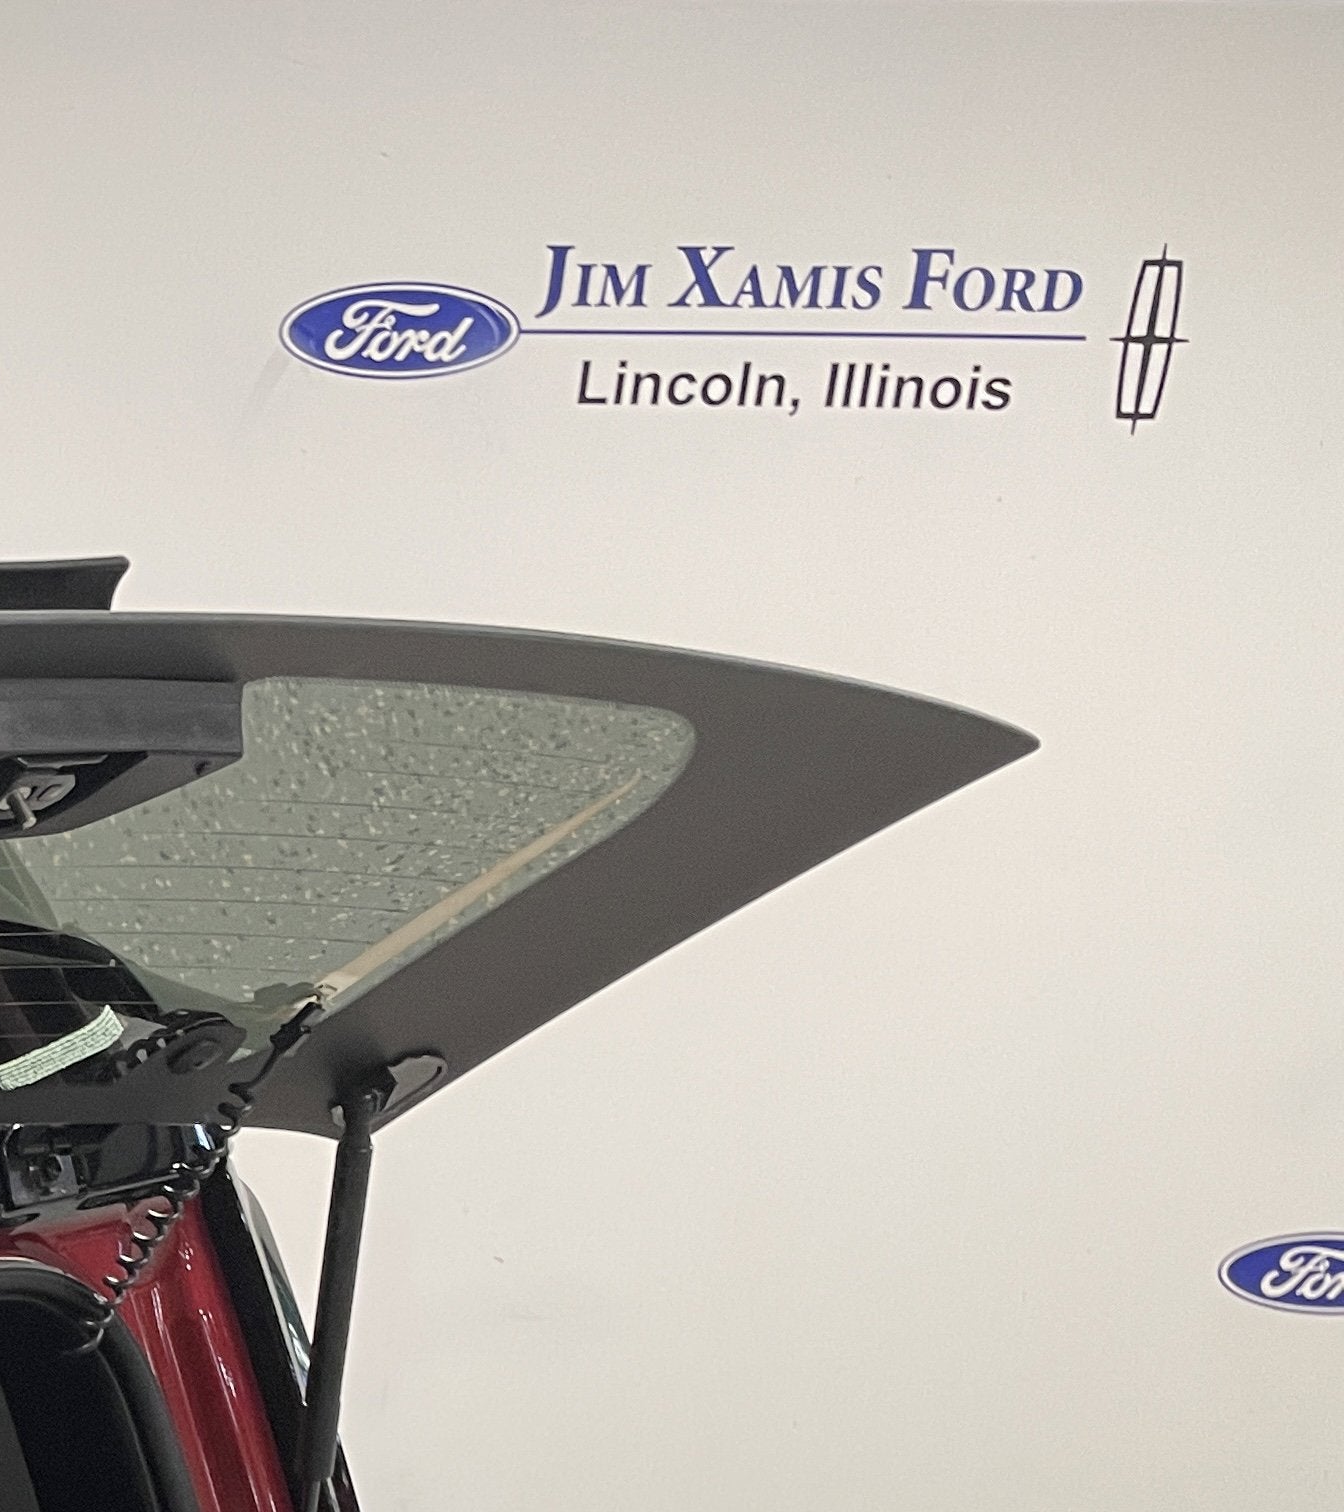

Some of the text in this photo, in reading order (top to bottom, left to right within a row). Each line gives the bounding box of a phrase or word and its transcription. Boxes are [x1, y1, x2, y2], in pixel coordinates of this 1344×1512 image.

[667, 245, 883, 311] XAMIS
[902, 248, 1083, 314] FORD
[324, 299, 475, 363] Ford
[577, 360, 1012, 415] Lincoln, Illinois
